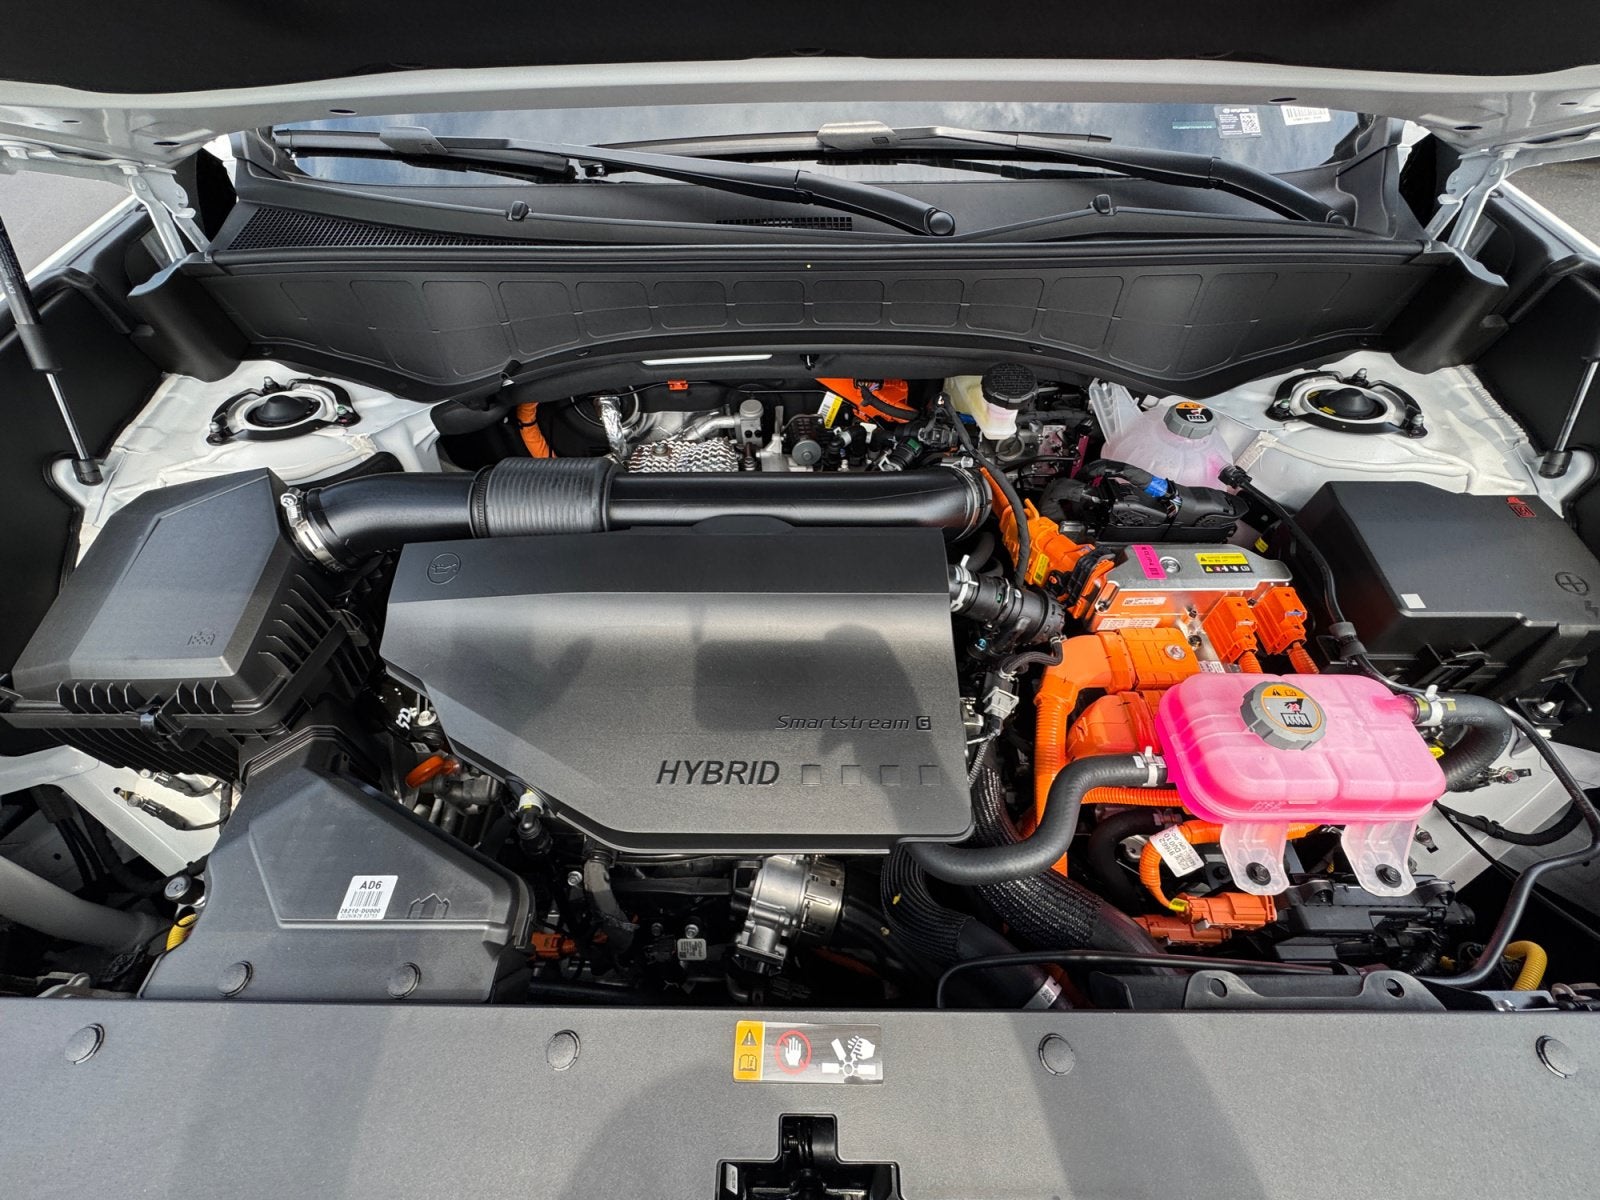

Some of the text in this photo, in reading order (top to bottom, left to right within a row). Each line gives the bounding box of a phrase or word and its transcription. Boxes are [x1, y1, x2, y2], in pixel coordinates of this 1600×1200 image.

[775, 714, 932, 731] Smartstream G
[656, 760, 780, 786] HYBRID
[359, 880, 383, 890] AD6
